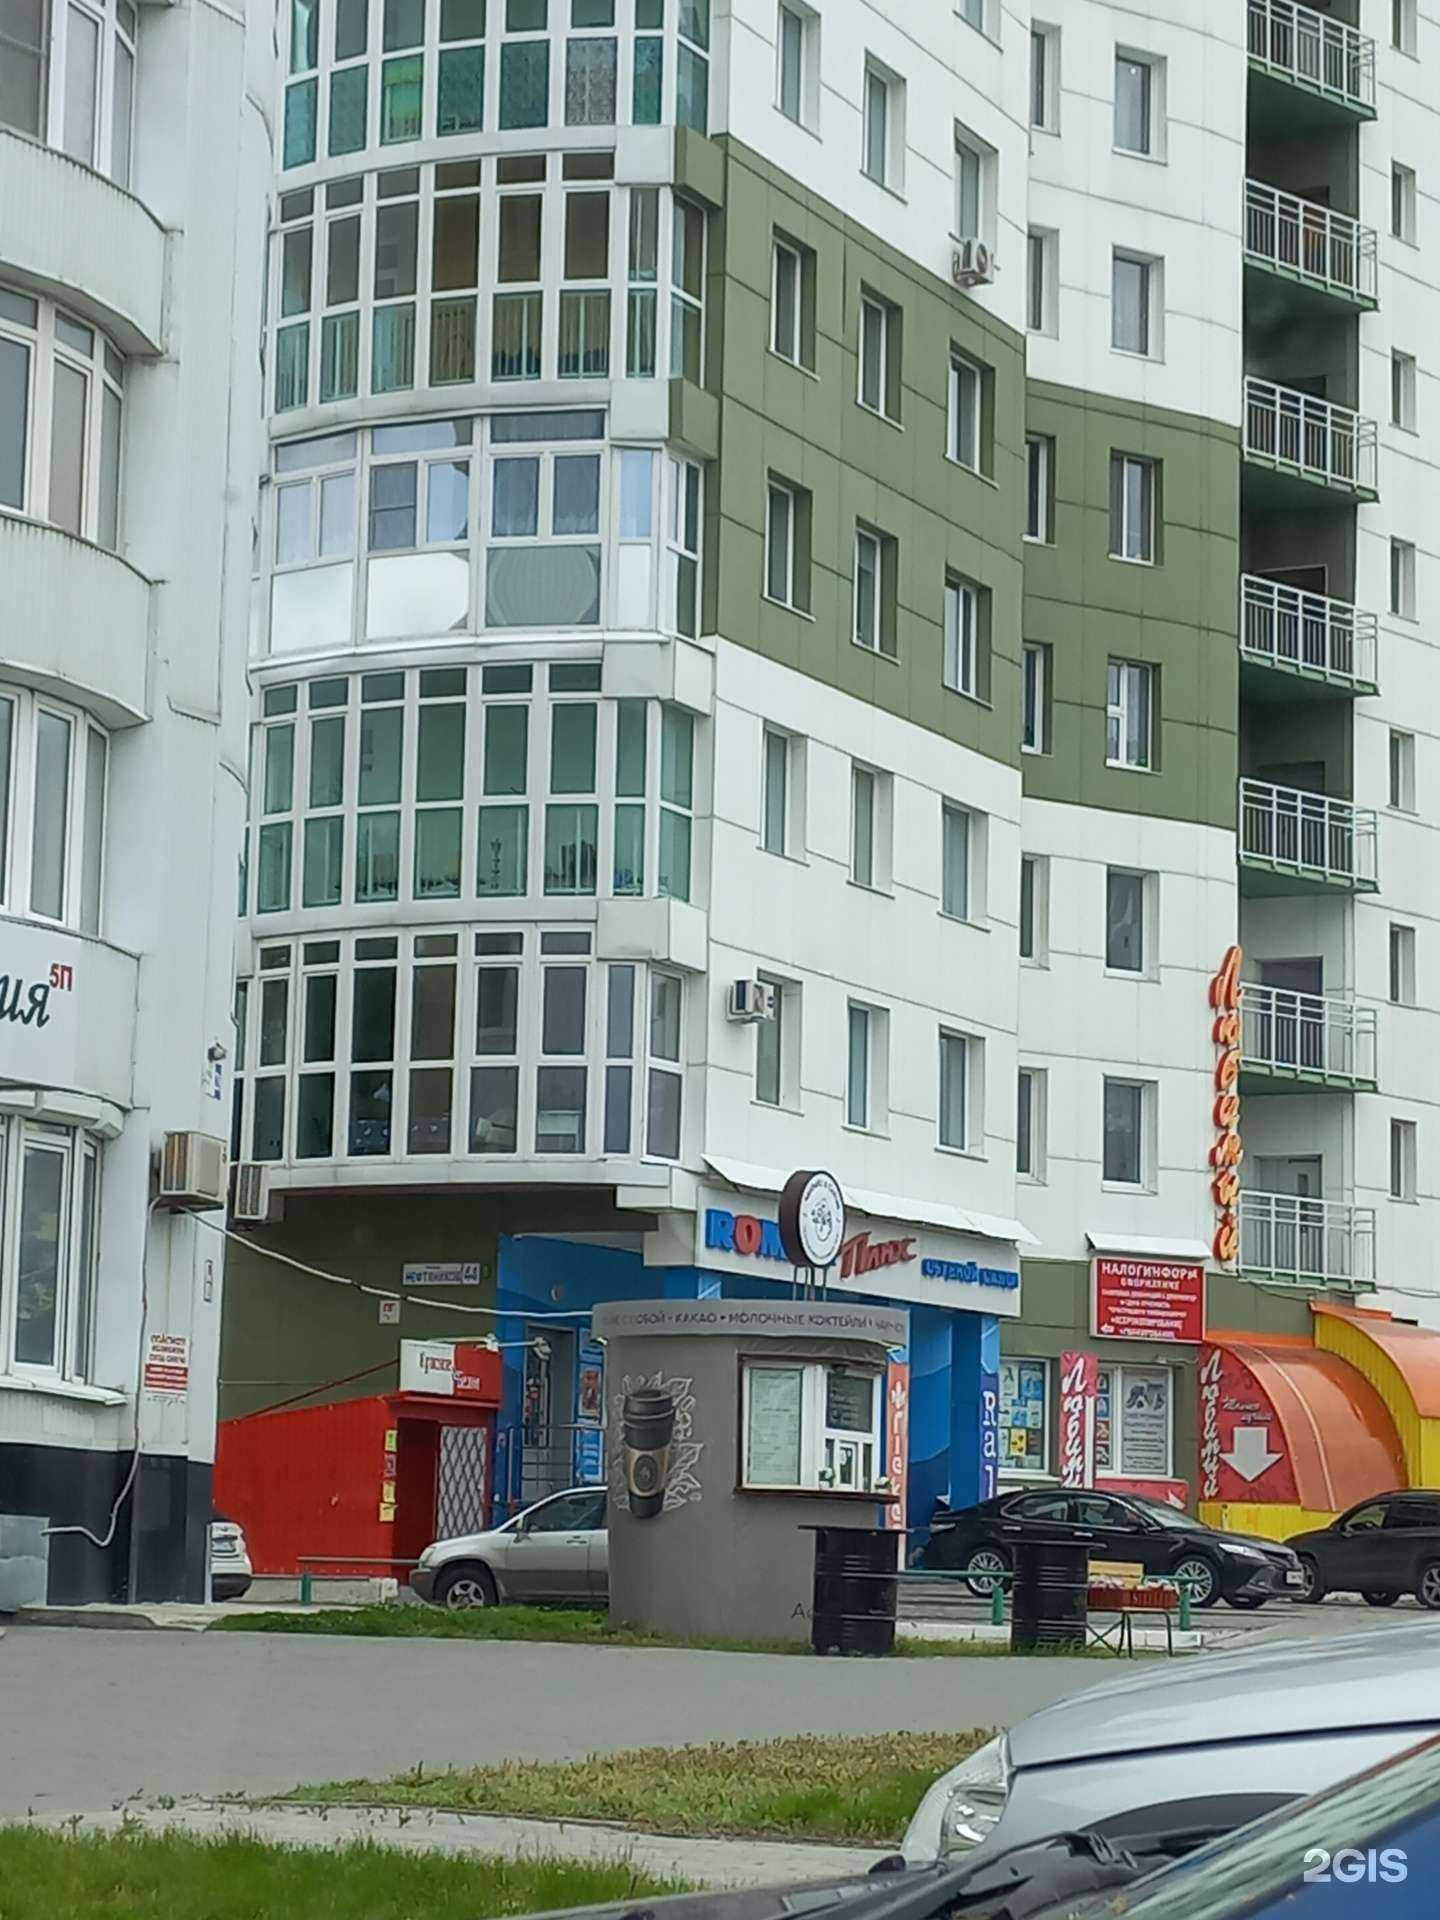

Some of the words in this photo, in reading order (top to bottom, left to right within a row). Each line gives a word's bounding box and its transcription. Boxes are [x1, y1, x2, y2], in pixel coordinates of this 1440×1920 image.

[706, 1208, 789, 1263] ROM
[675, 1312, 717, 1324] КАКАО
[729, 1312, 805, 1327] МОЛОЧНЫЕ
